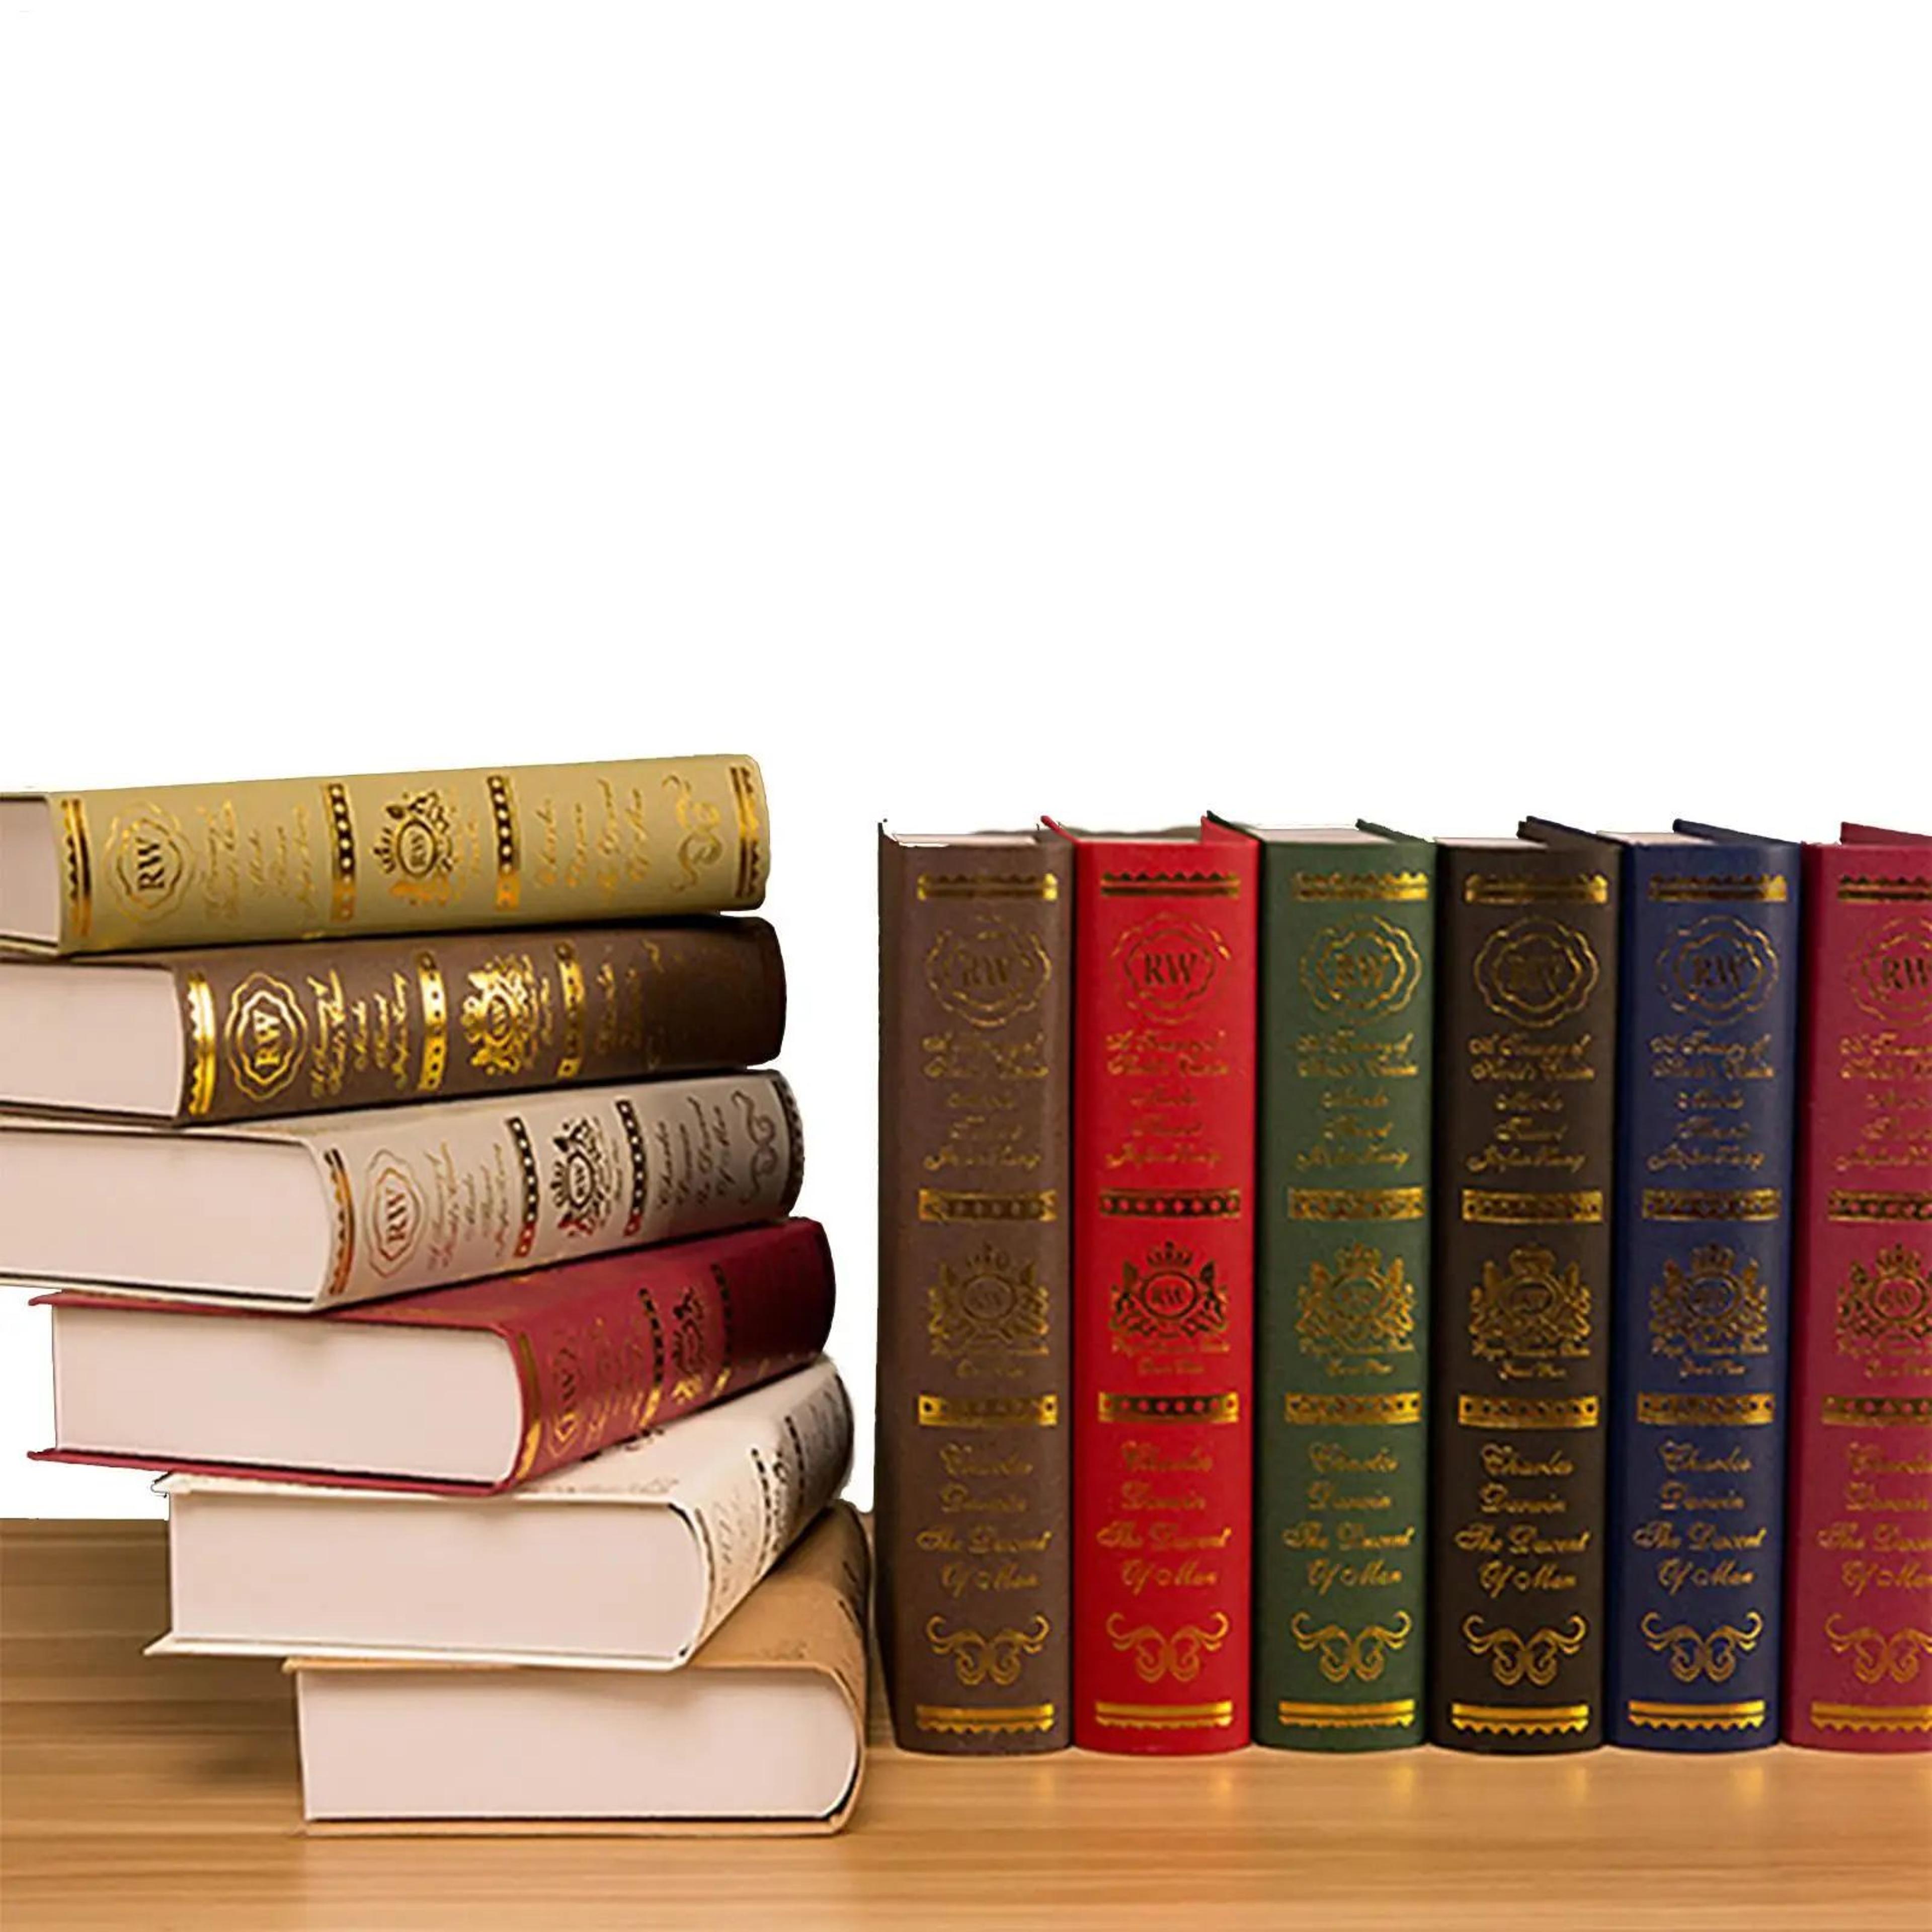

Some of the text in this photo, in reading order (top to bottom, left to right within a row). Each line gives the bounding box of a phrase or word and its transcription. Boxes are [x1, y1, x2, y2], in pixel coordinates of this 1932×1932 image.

[136, 836, 165, 892] RW
[1143, 953, 1197, 986] RW
[1335, 954, 1391, 988] RW
[1692, 956, 1747, 988] RW
[1882, 956, 1932, 990] RW
[253, 1008, 281, 1069] RW
[385, 1187, 407, 1243] RW
